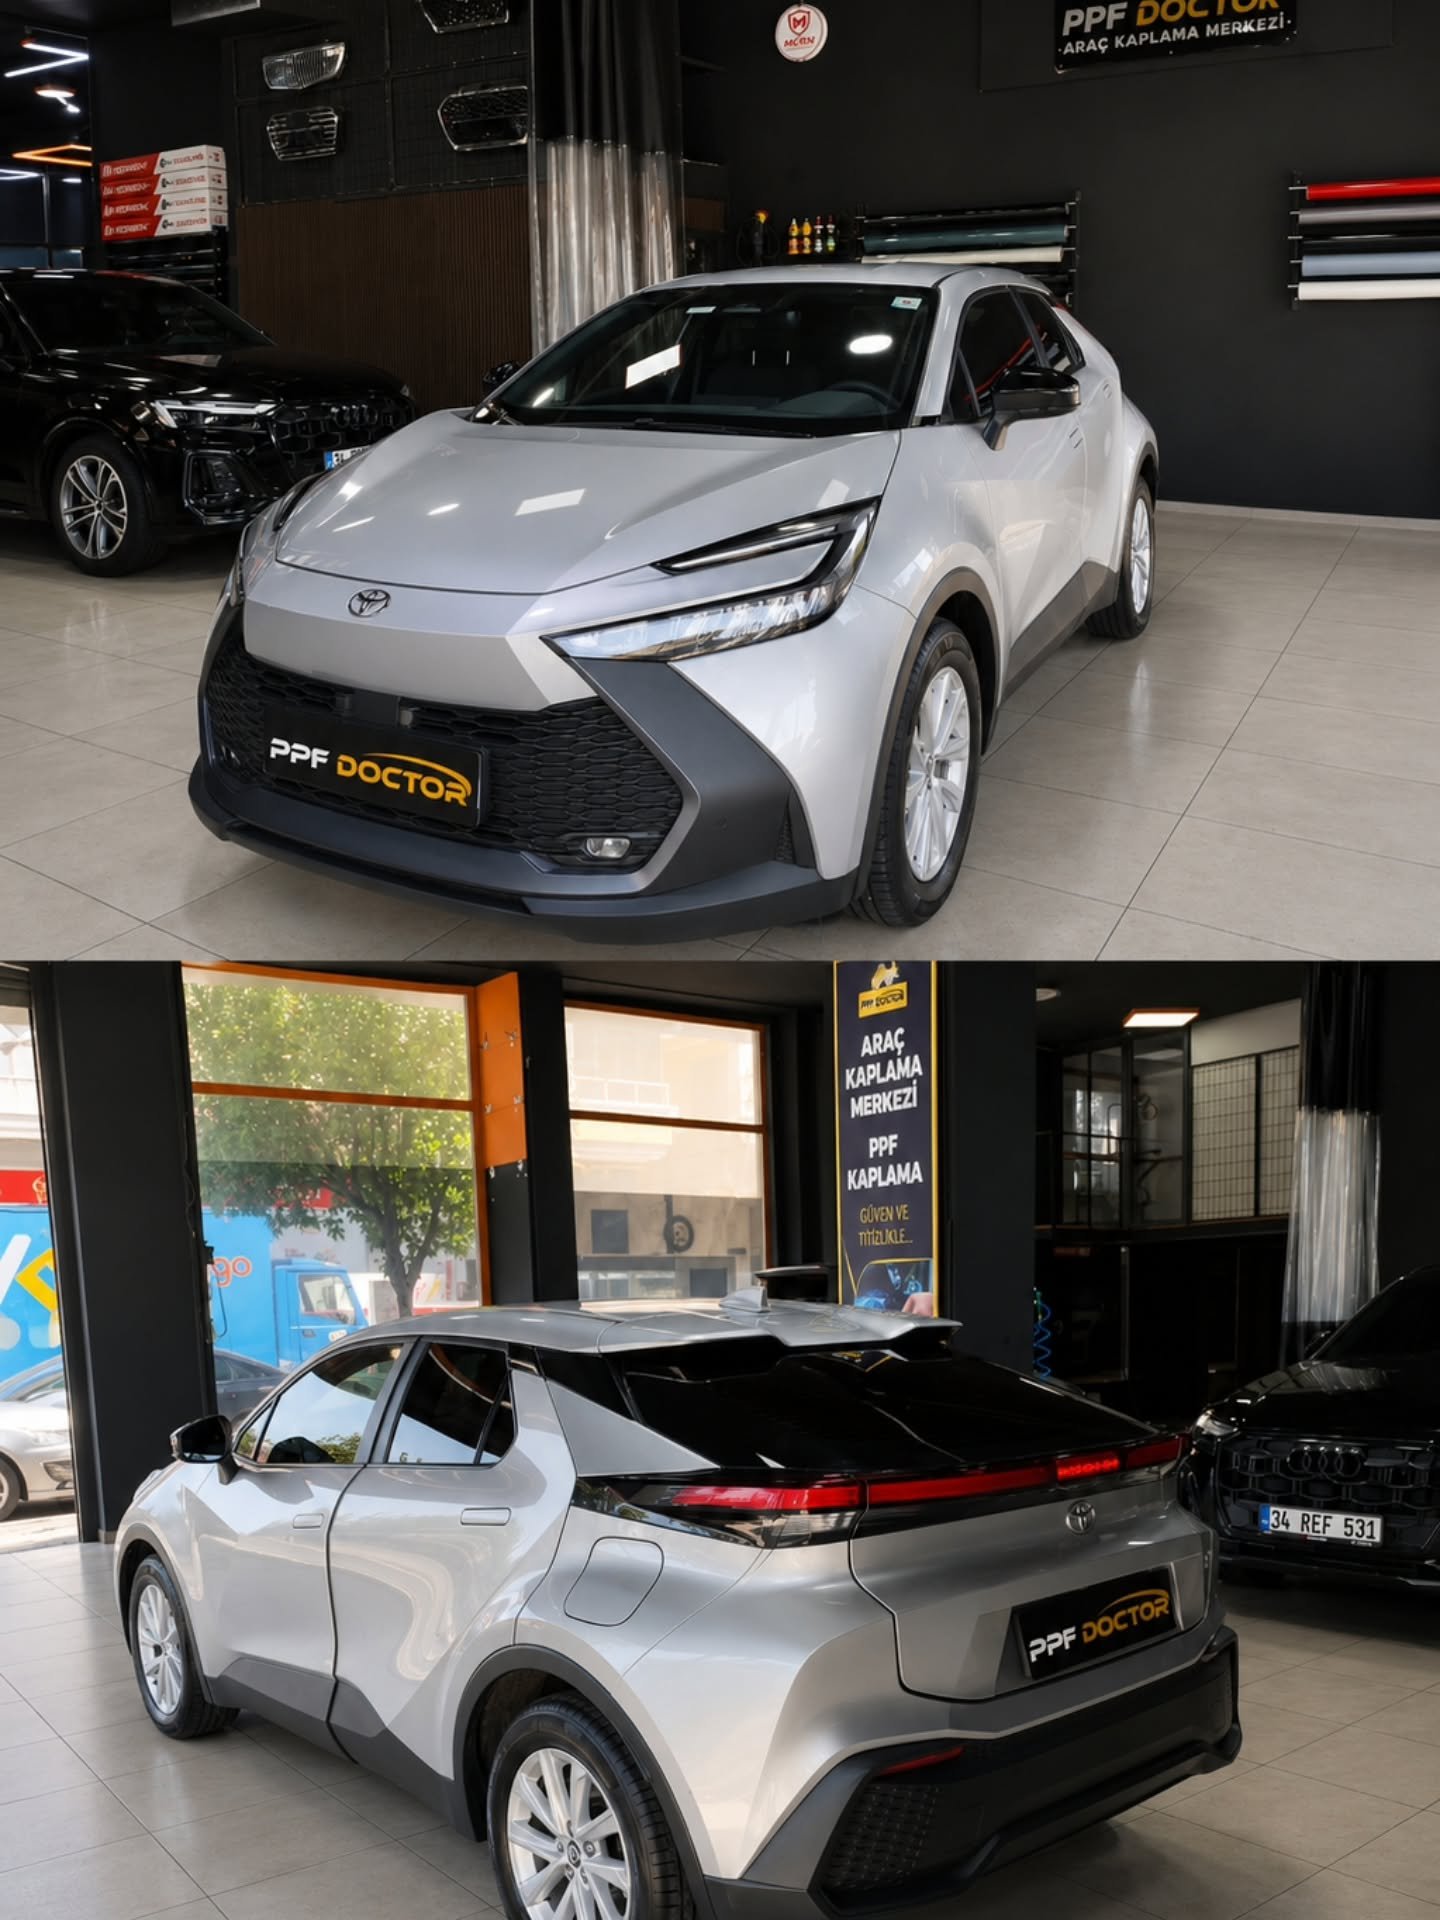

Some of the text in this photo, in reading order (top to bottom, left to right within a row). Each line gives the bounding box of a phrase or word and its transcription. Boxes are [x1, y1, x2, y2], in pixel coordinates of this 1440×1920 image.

[1062, 2, 1128, 36] PPF
[1062, 12, 1285, 55] ARAÇ KAPLAMA MERKEZİ
[269, 737, 469, 807] PPF DOCTOR
[861, 1027, 905, 1058] ARAÇ
[845, 1054, 923, 1090] KAPLAMA
[850, 1079, 917, 1119] MERKEZİ
[869, 1134, 898, 1159] PPF
[847, 1161, 923, 1191] KAPLAMA
[859, 1204, 909, 1224] GÜVEN VE
[1270, 1510, 1376, 1540] 34 REF 531
[1029, 1597, 1169, 1663] PPF DOCTOR
